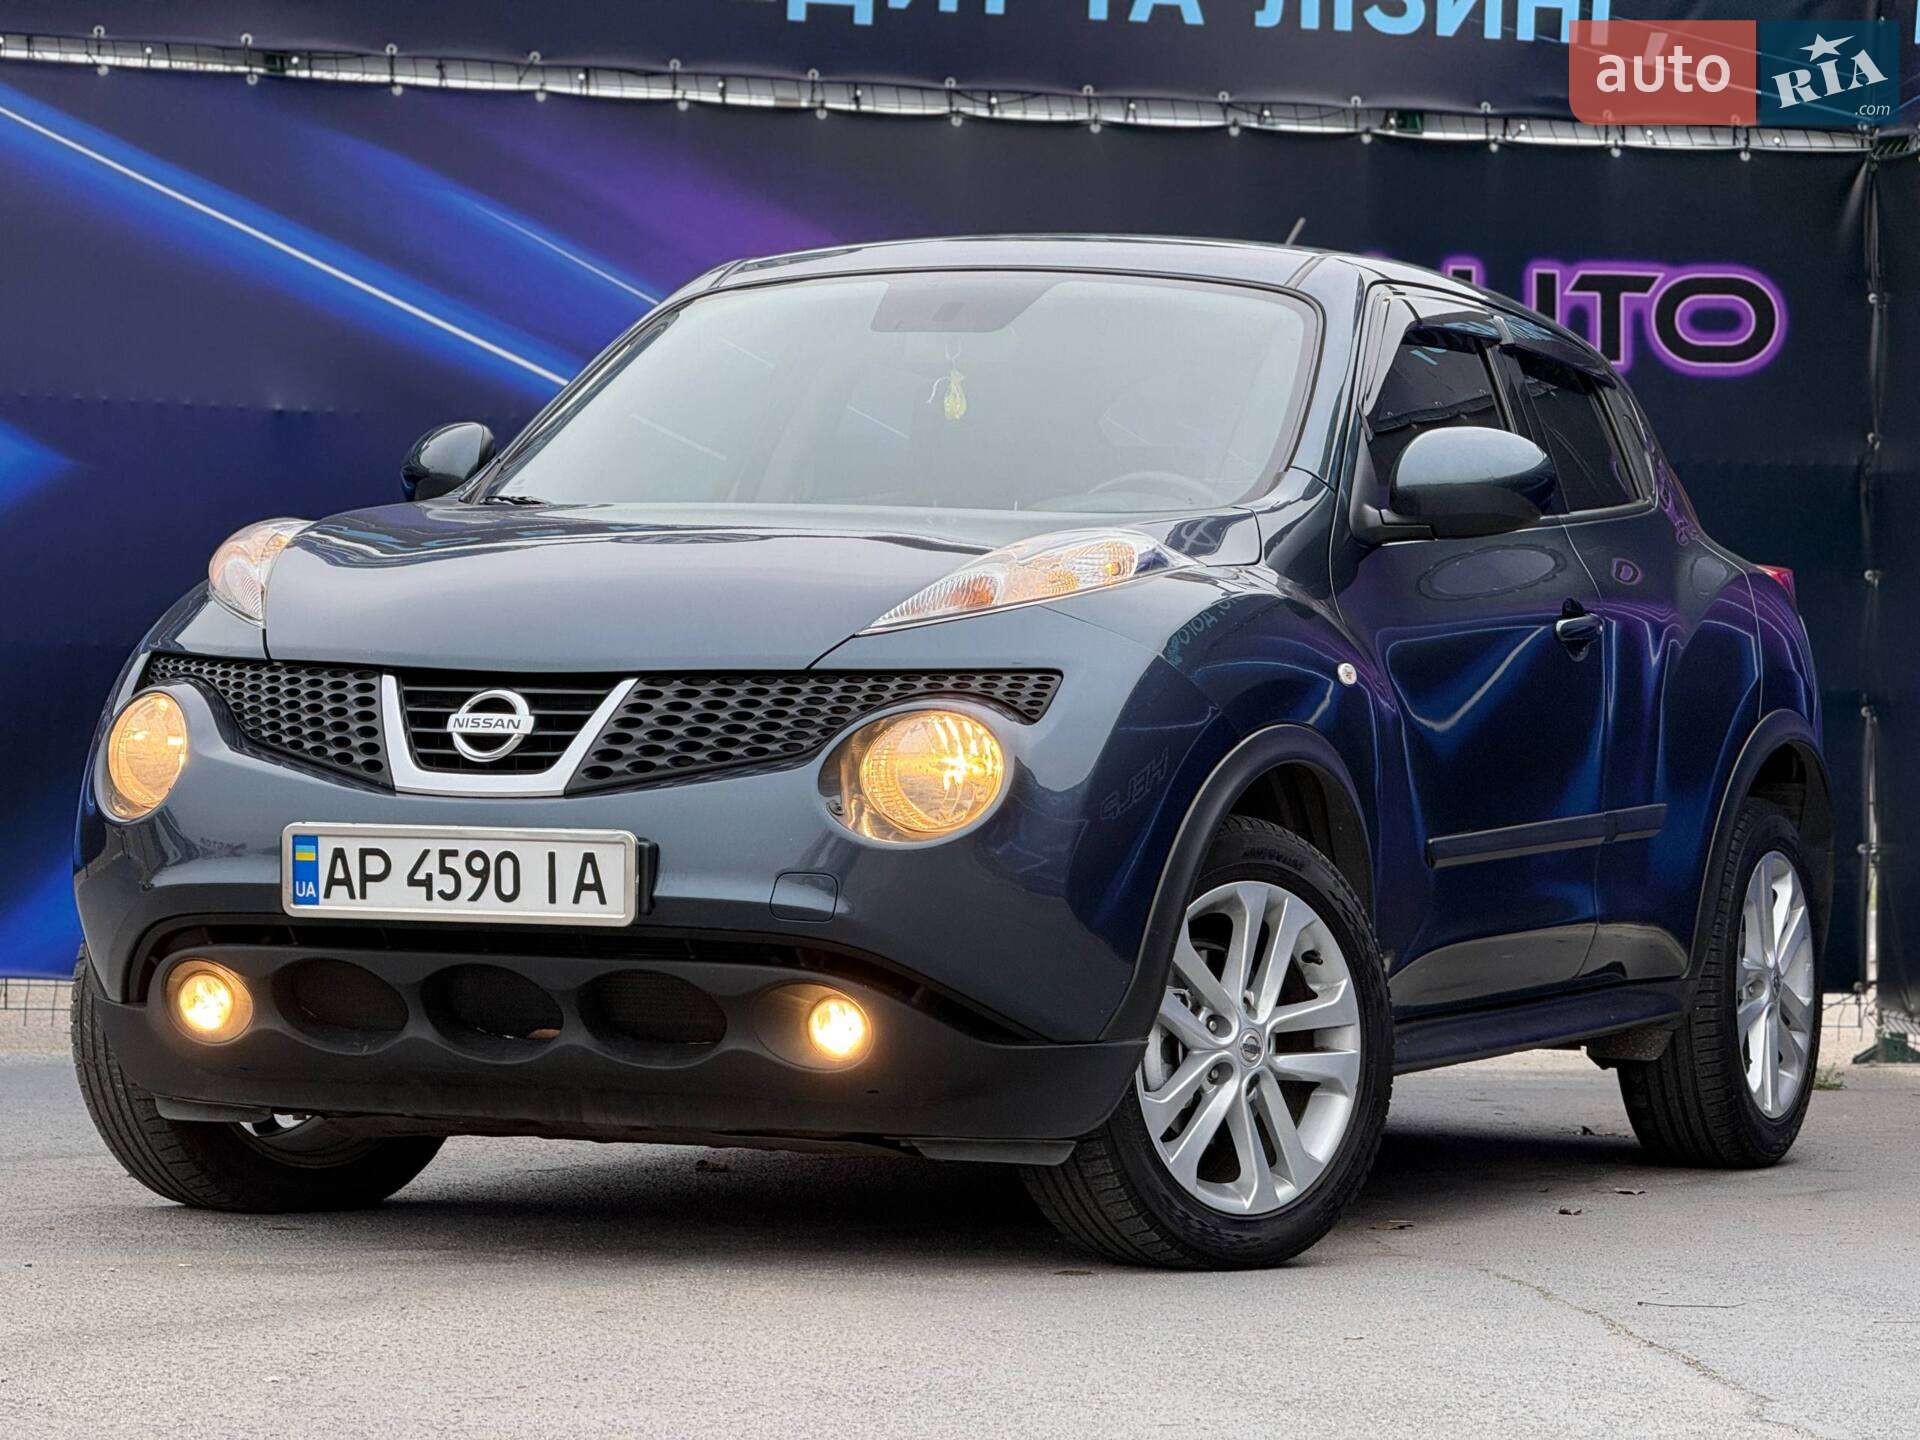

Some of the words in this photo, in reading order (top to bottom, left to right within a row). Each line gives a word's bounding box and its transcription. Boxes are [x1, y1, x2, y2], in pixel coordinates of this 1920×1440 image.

[453, 717, 522, 730] NISSAN
[323, 847, 392, 900] AP
[406, 847, 521, 904] 4590
[547, 850, 608, 905] IA
[295, 880, 317, 898] UA
